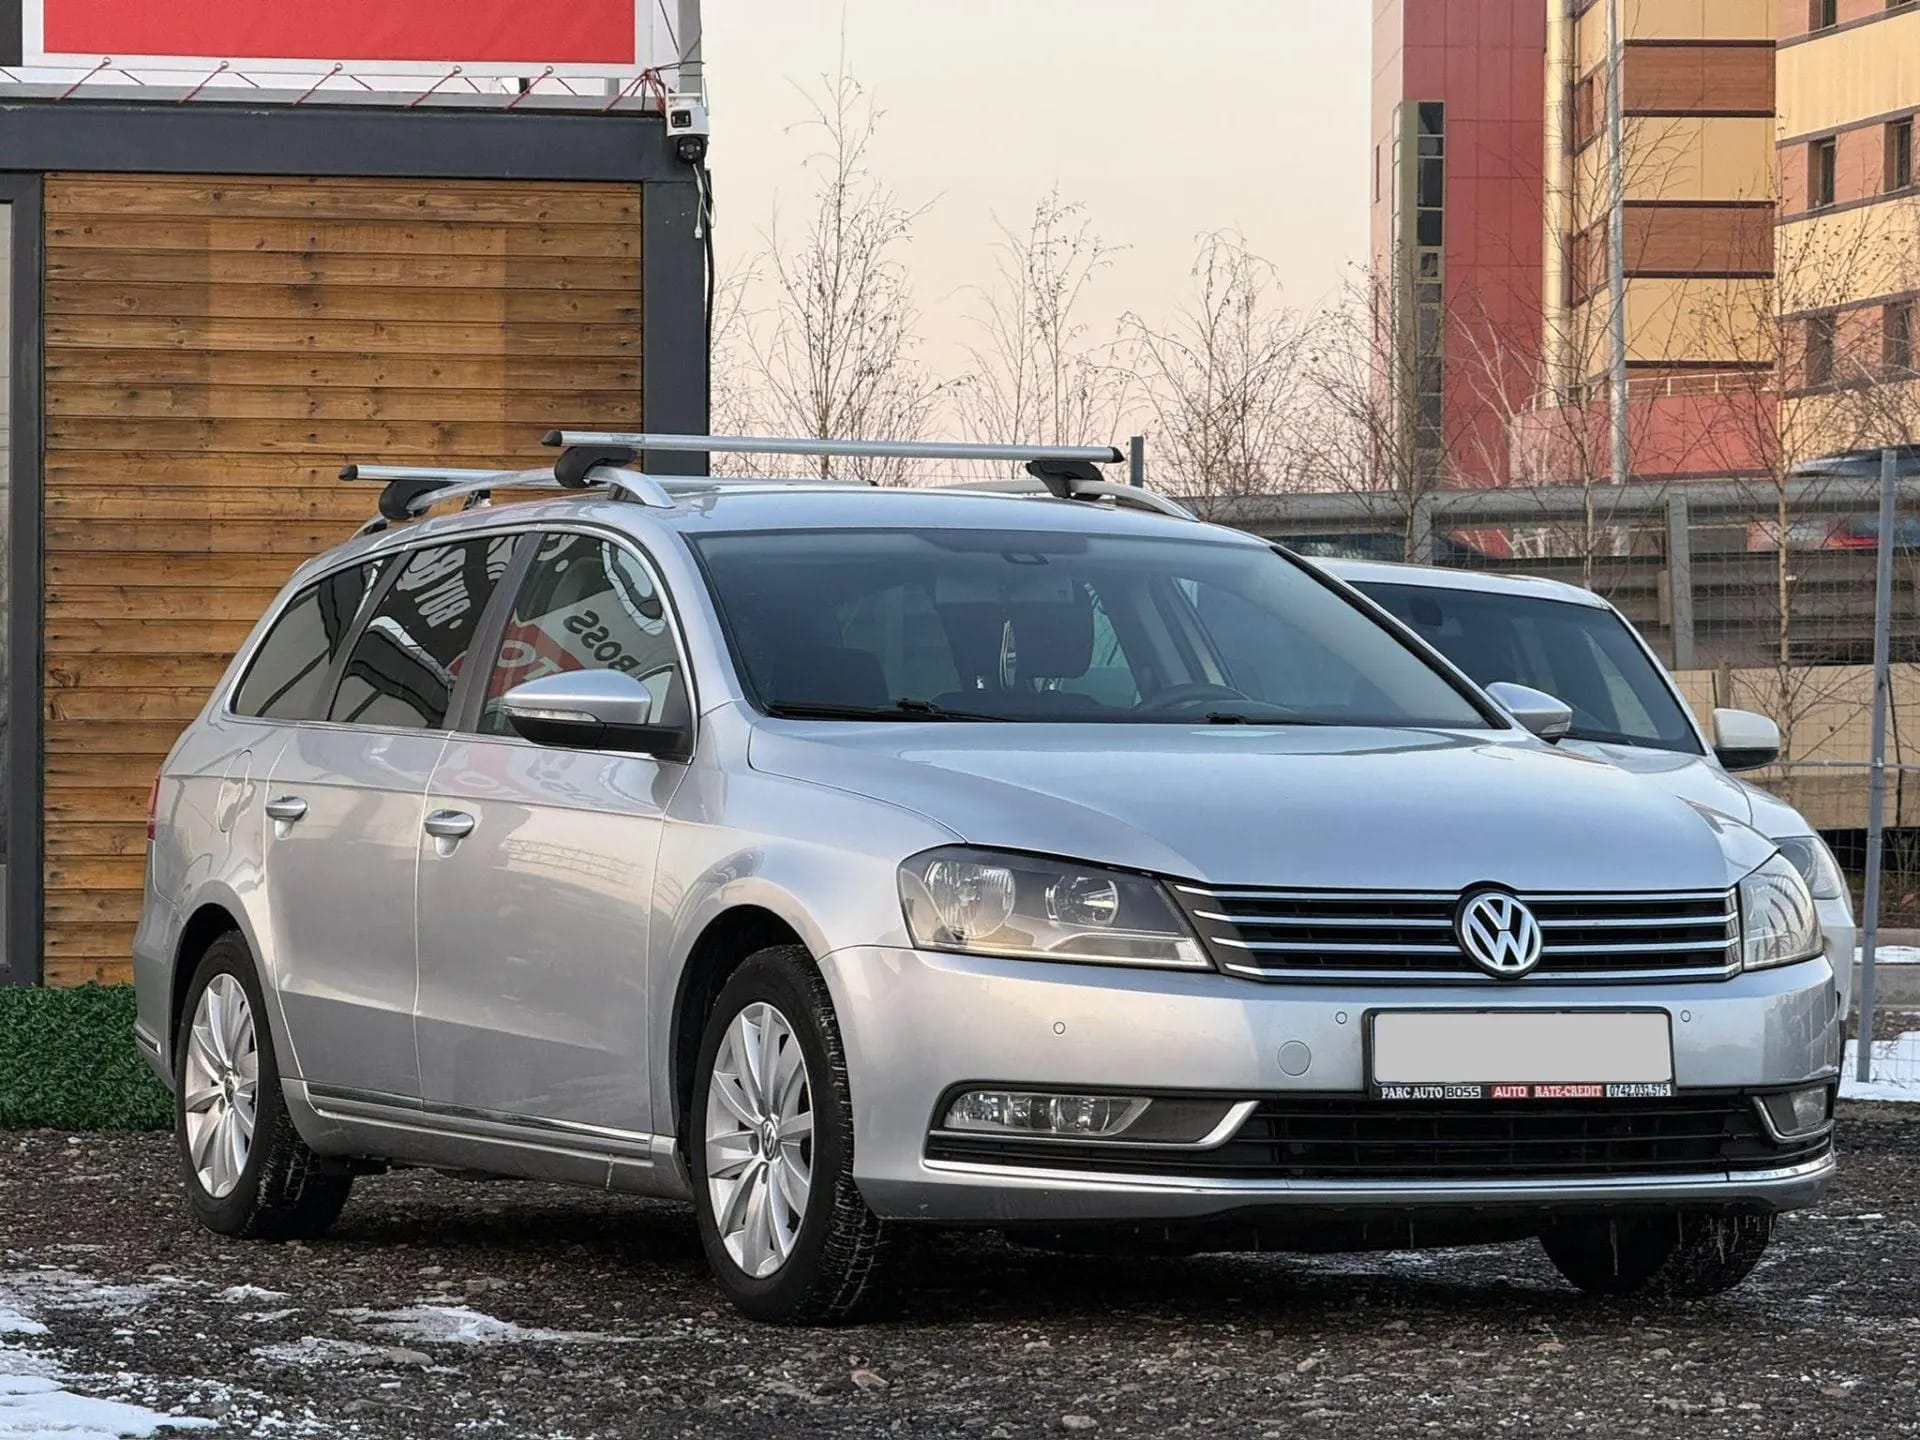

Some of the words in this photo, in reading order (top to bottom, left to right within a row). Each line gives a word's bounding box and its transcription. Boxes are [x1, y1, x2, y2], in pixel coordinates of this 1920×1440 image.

[1381, 1086, 1411, 1099] PARC
[1412, 1086, 1443, 1099] AUTO
[1446, 1086, 1480, 1098] BOSS
[1493, 1085, 1527, 1098] AUTO
[1535, 1084, 1602, 1097] RATE-CREDIT
